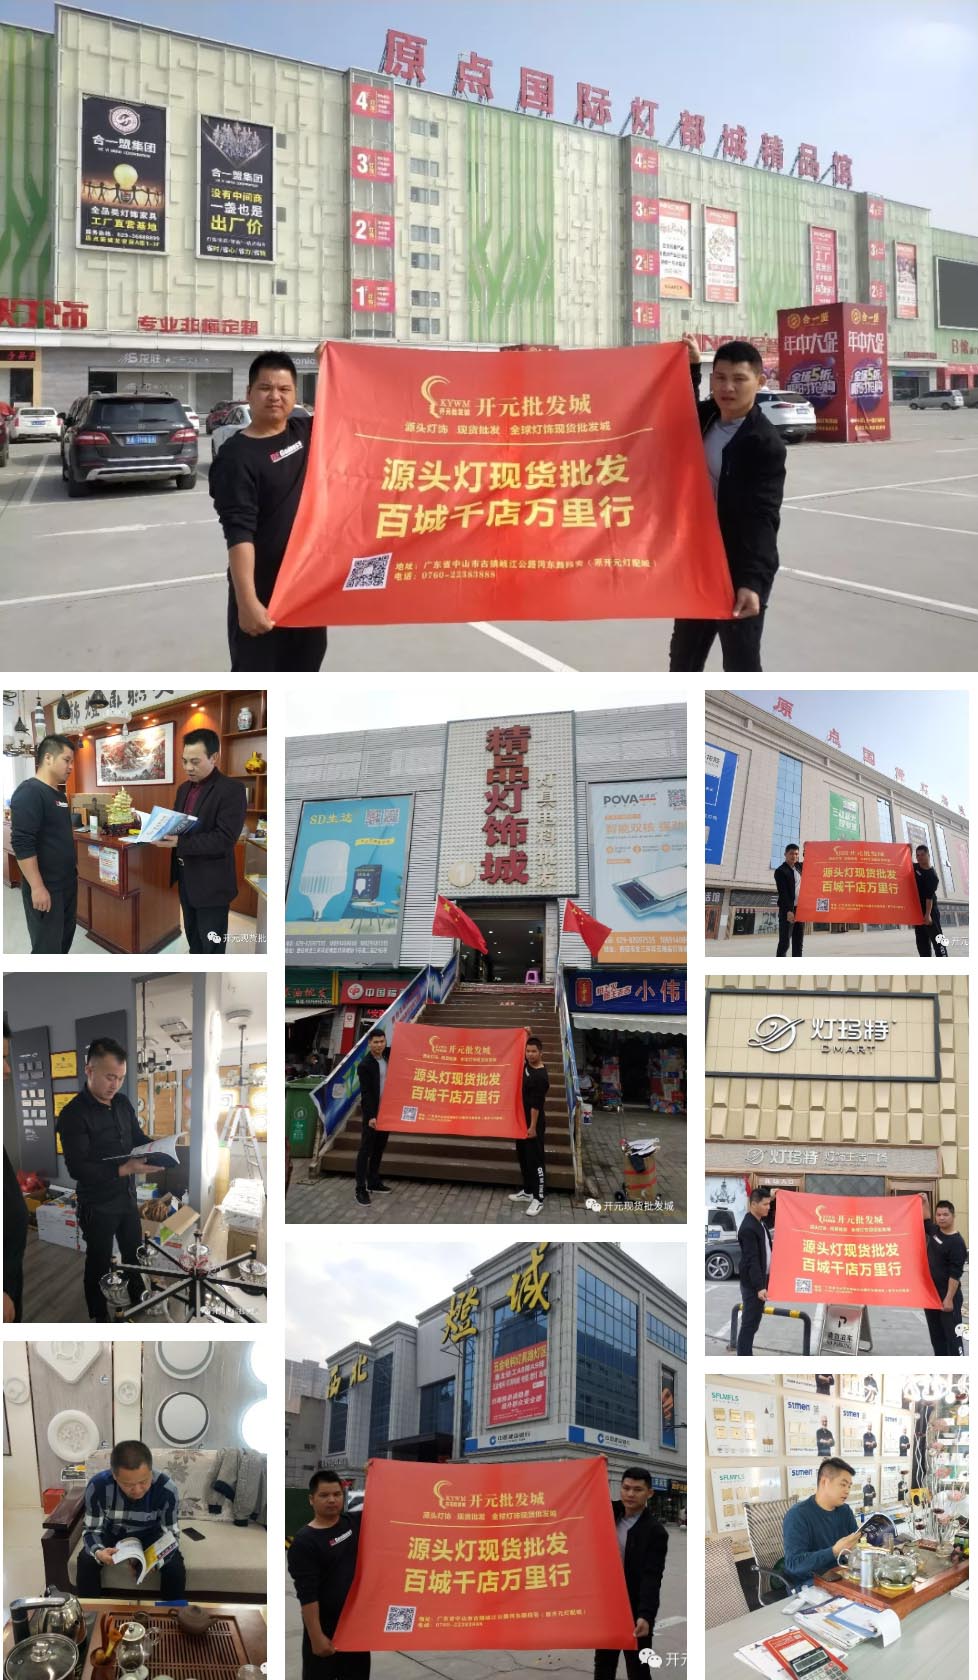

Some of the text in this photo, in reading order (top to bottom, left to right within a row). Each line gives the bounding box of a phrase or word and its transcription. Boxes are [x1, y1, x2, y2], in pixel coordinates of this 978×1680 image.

[383, 28, 852, 187] 原点国际灯都城精品馆
[92, 134, 156, 154] 合一盟集团
[211, 188, 263, 204] 没有中间商
[210, 201, 263, 218] 一盏也是
[91, 216, 158, 232] 工厂直营基地
[210, 214, 263, 235] 出厂价
[784, 331, 838, 356] 年中大促
[848, 330, 885, 354] 年中大促
[476, 394, 592, 417] 开元批发城
[405, 423, 449, 434] 源头灯饰
[457, 424, 501, 435] 现货批发
[381, 453, 631, 493] 源头灯现货批发
[375, 495, 634, 539] 百城千店万里行
[480, 724, 531, 885] 精品灯饰城
[603, 794, 639, 805] POVA
[823, 867, 897, 880] 源头灯现货批发
[822, 880, 898, 895] 百城千店万里行
[811, 1017, 889, 1041] 灯玛特
[413, 1067, 501, 1087] 源头灯现货批发
[411, 1085, 501, 1105] 百城千店万里行
[770, 1150, 819, 1165] 灯玛特
[837, 1215, 883, 1225] 开元批发城
[802, 1239, 900, 1258] 源头灯现货批发
[802, 1257, 902, 1277] 百城千店万里行
[470, 1491, 545, 1508] 开元批发城
[407, 1532, 568, 1562] 源头灯现货批发
[403, 1563, 572, 1595] 百城千店万里行
